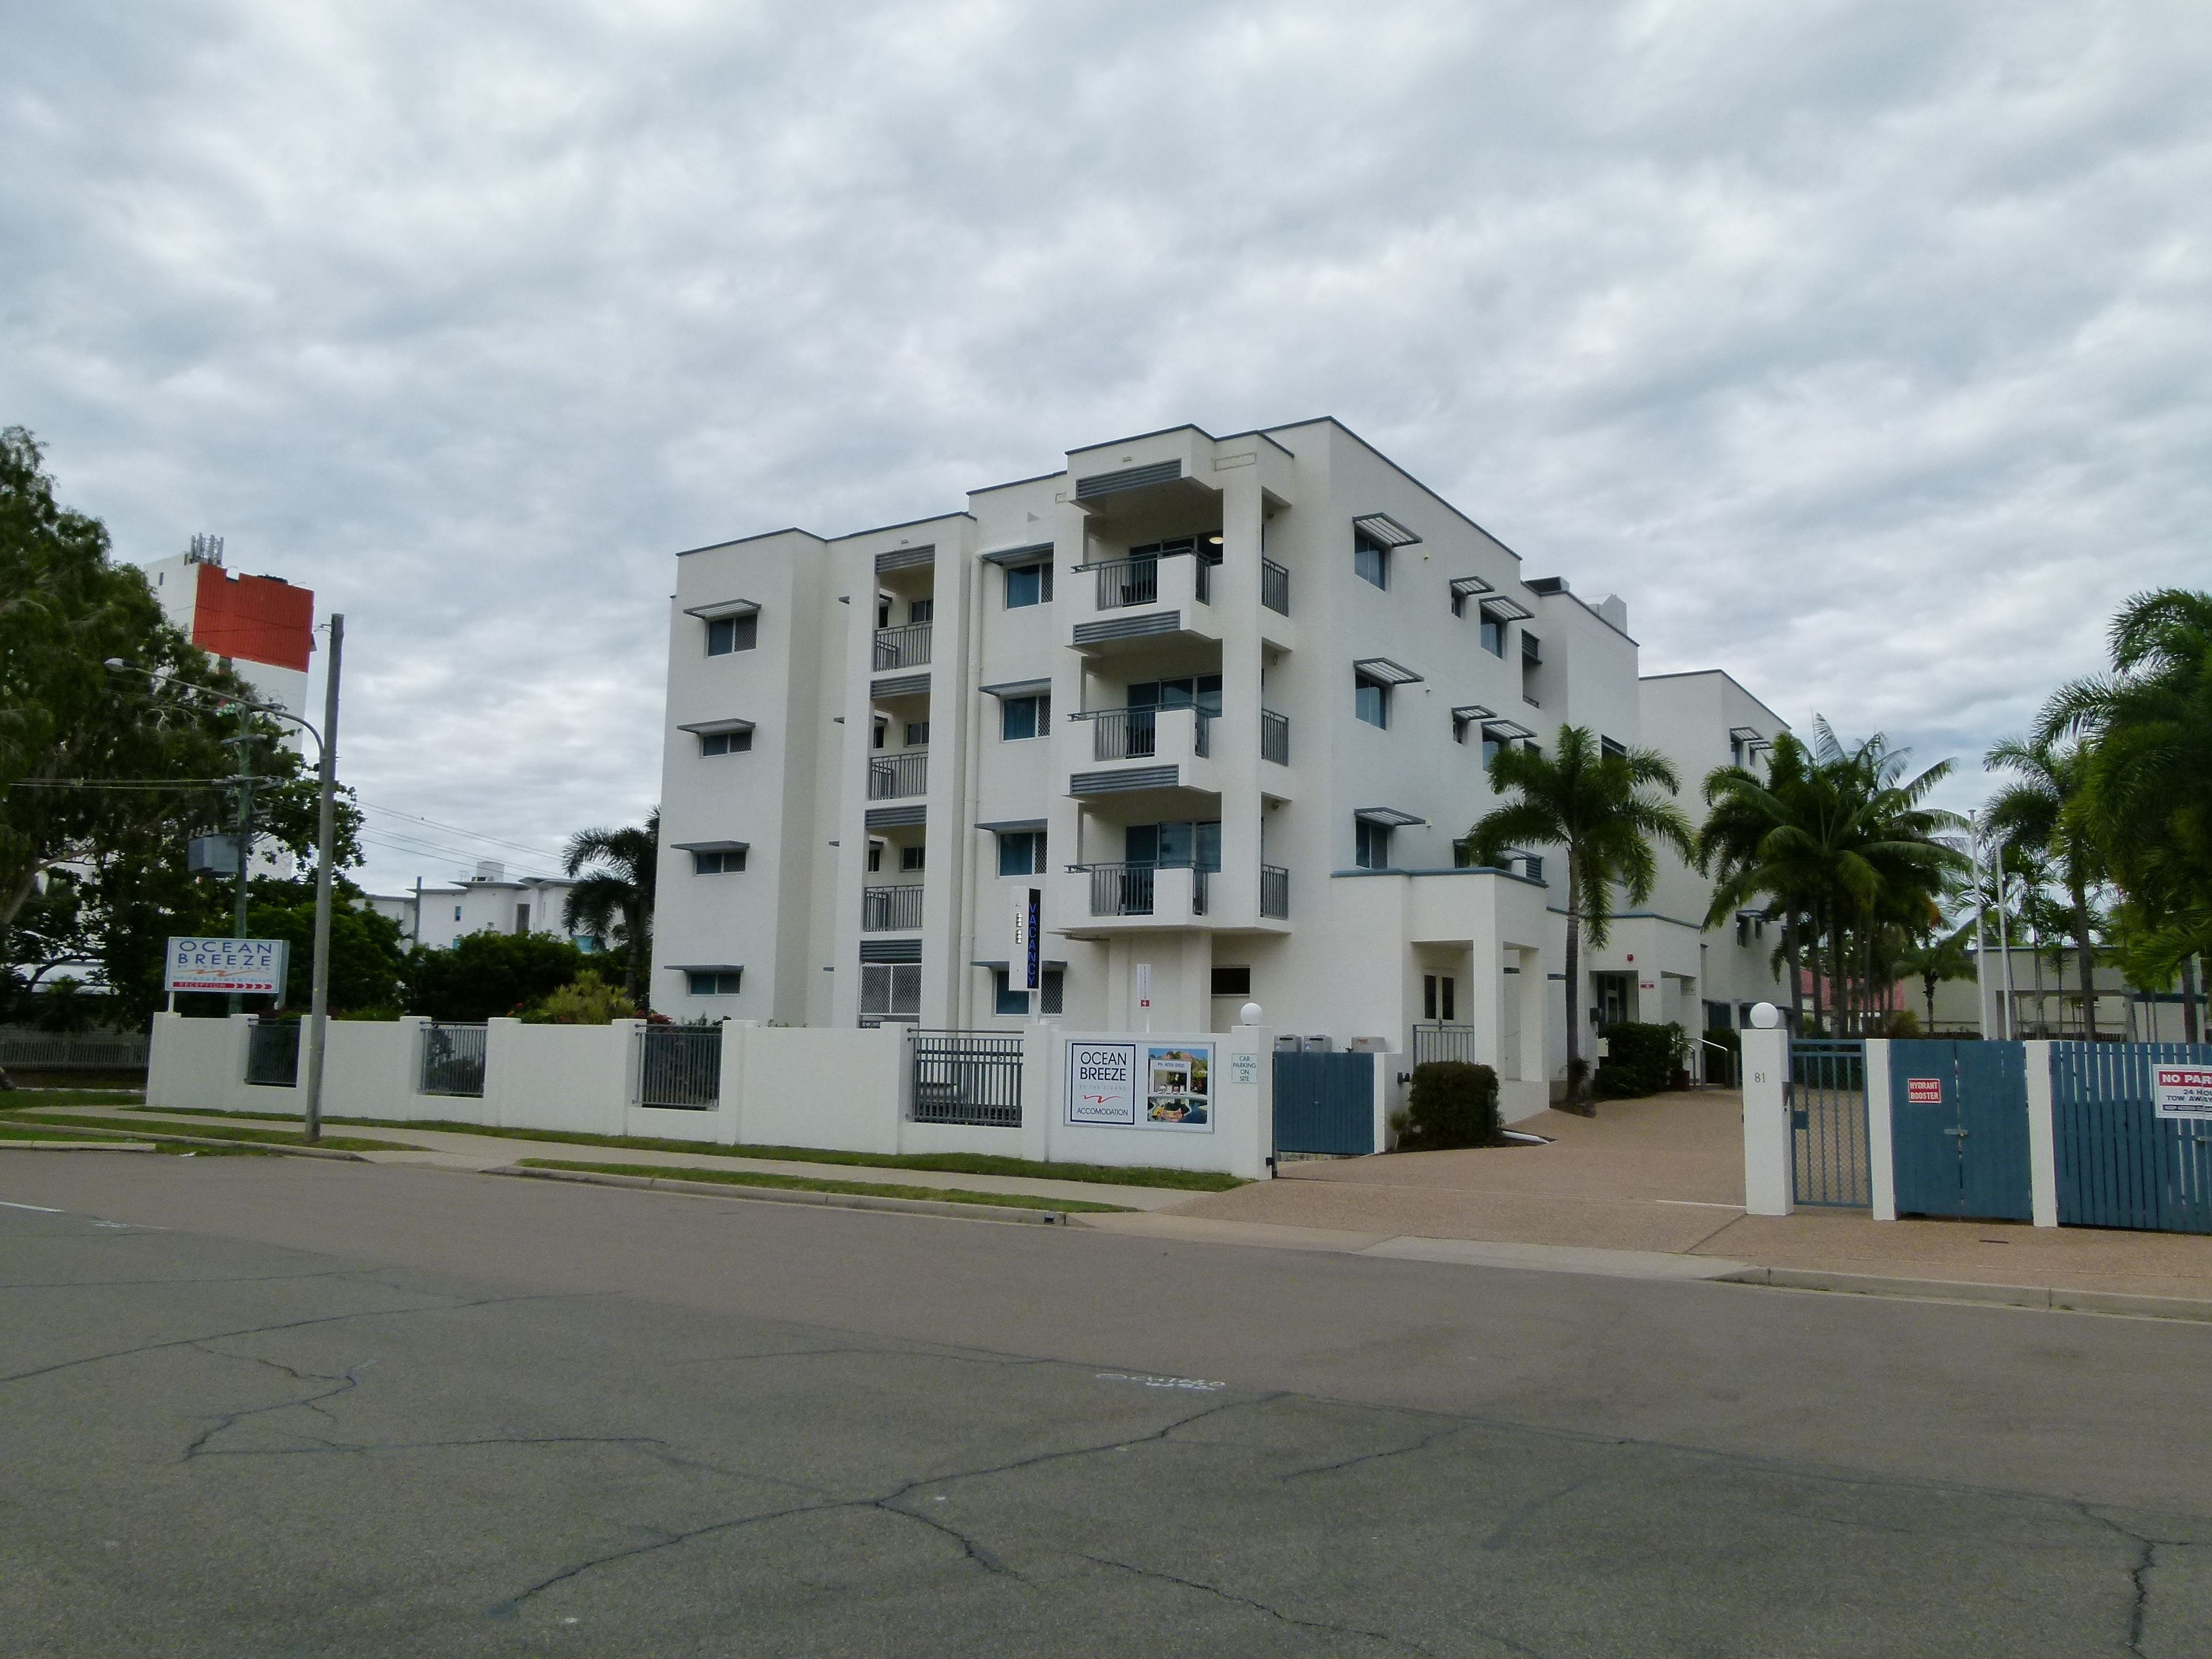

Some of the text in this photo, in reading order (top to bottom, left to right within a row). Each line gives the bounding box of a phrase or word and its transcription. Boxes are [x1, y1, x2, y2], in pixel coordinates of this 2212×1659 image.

[179, 941, 272, 953] OCEAN
[1028, 903, 1036, 986] VACANCY
[179, 953, 271, 966] BREEZE
[1081, 1052, 1126, 1065] OCEAN
[1080, 1067, 1126, 1081] BREEZE
[1754, 1072, 1765, 1083] 81
[2162, 1074, 2212, 1084] NO PAR
[1910, 1081, 1938, 1089] HYDRANT
[1910, 1092, 1939, 1100] BOOSTER
[1077, 1108, 1128, 1116] ACCOMODATION
